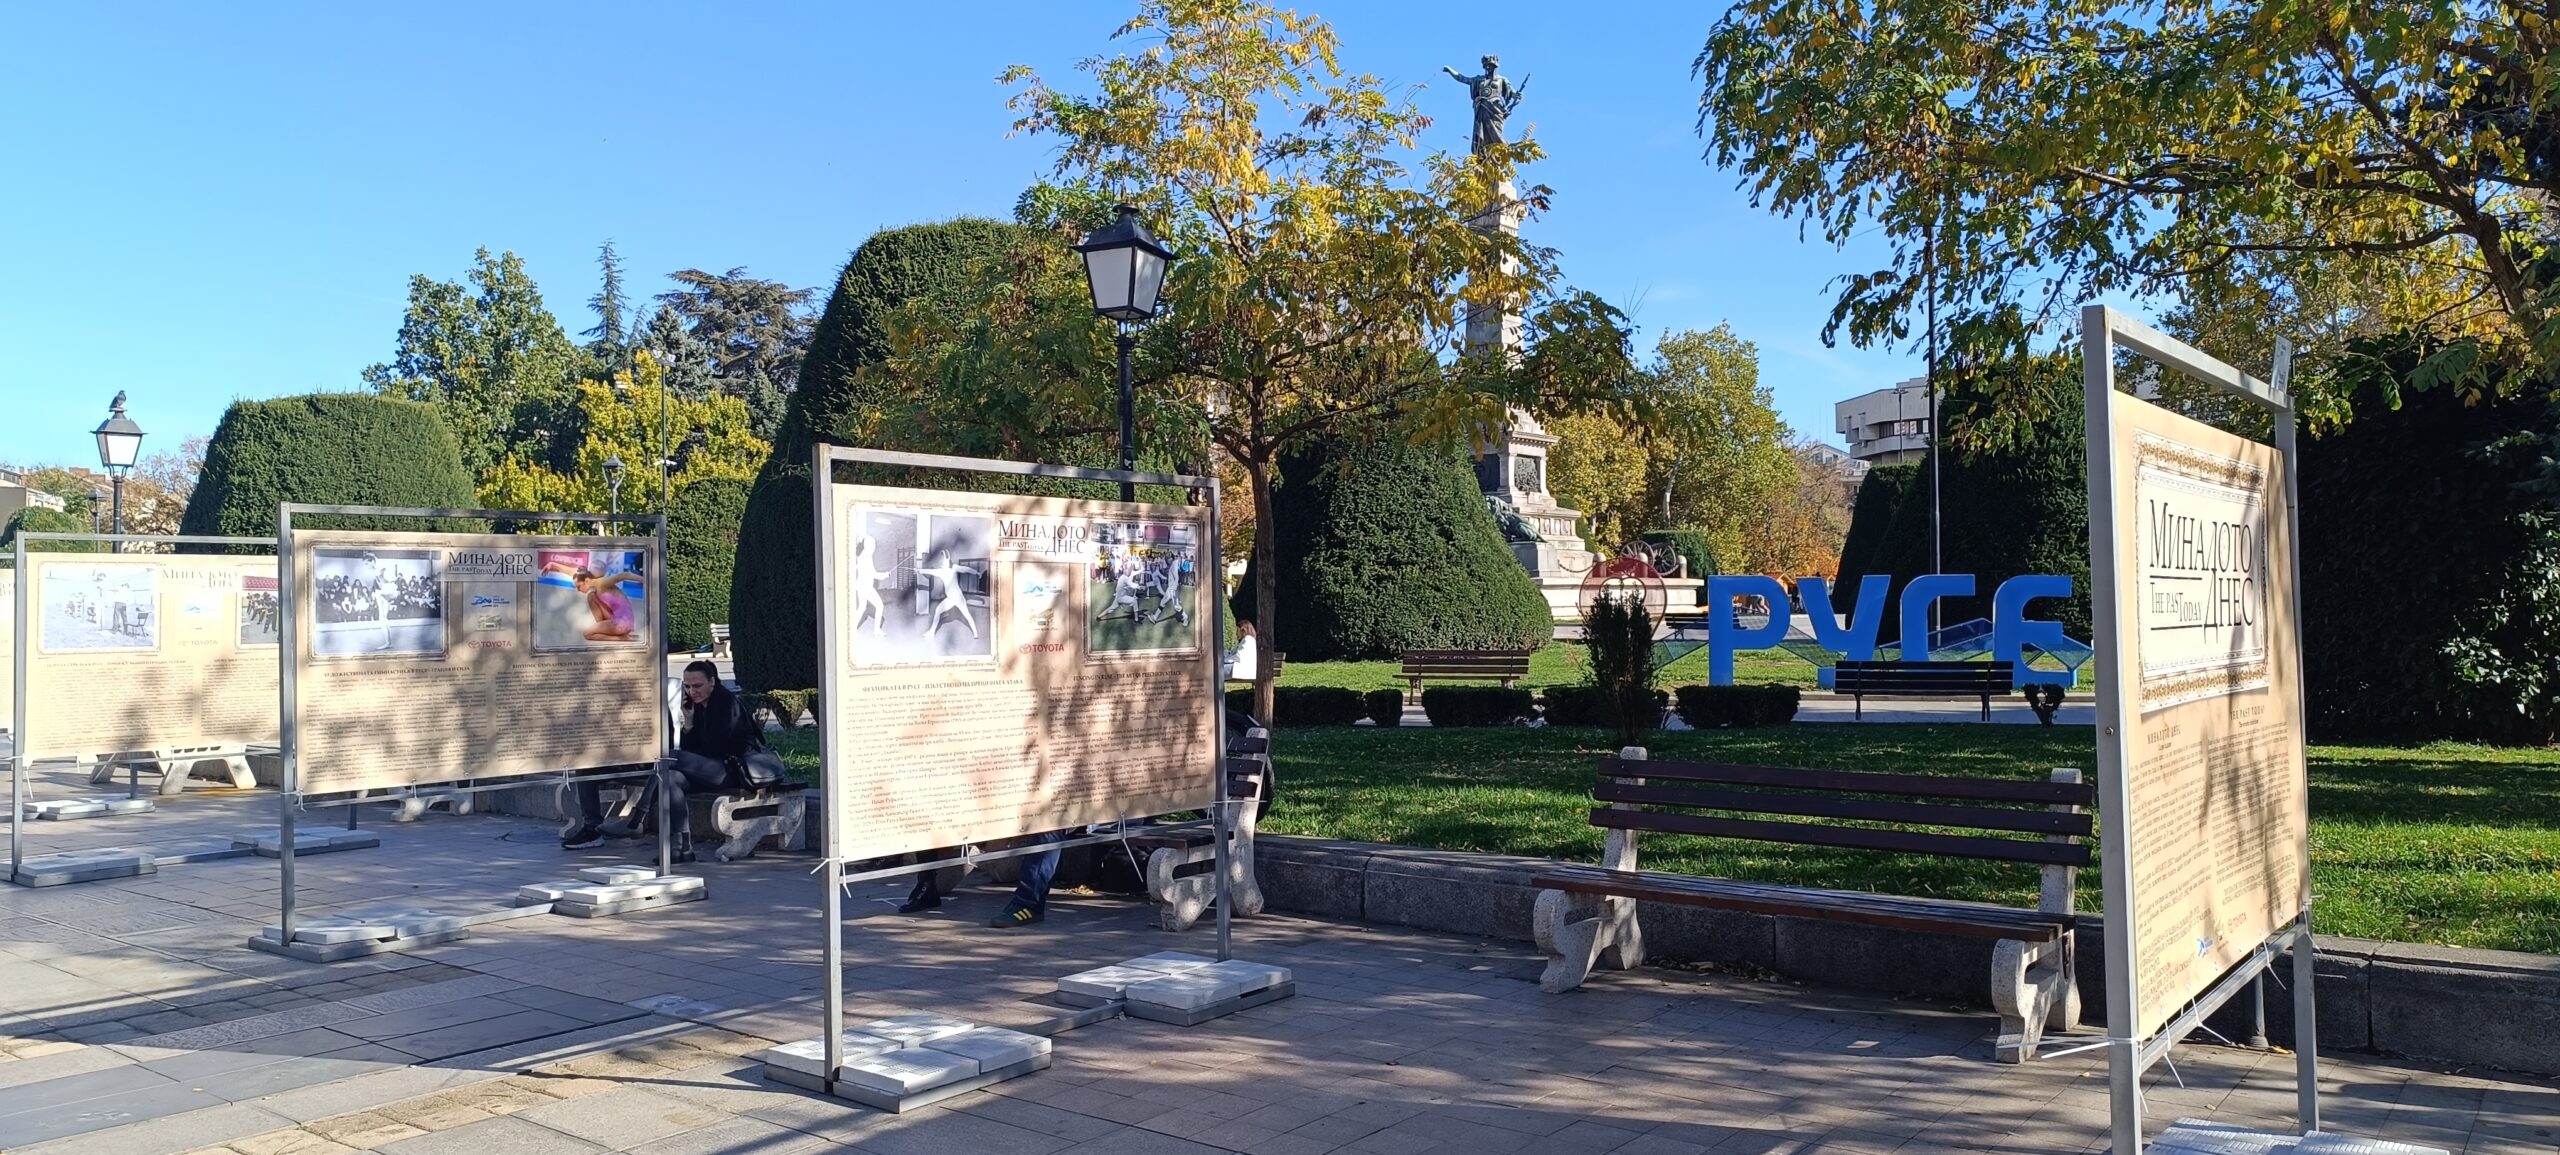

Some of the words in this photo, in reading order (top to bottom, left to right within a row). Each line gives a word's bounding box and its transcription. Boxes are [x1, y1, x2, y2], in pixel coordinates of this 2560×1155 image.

[998, 519, 1086, 540] МИНАЛОТО
[2149, 499, 2253, 573] МИНАЛОТО
[1045, 538, 1086, 556] ДНЕС
[448, 552, 533, 565] МИНАЛОТО
[492, 563, 533, 577] ДНЕС
[2203, 569, 2254, 644] ДНЕС
[1708, 574, 2072, 689] РУСЕ
[480, 640, 512, 649] TOYOTA
[1032, 643, 1065, 653] TOYOTA
